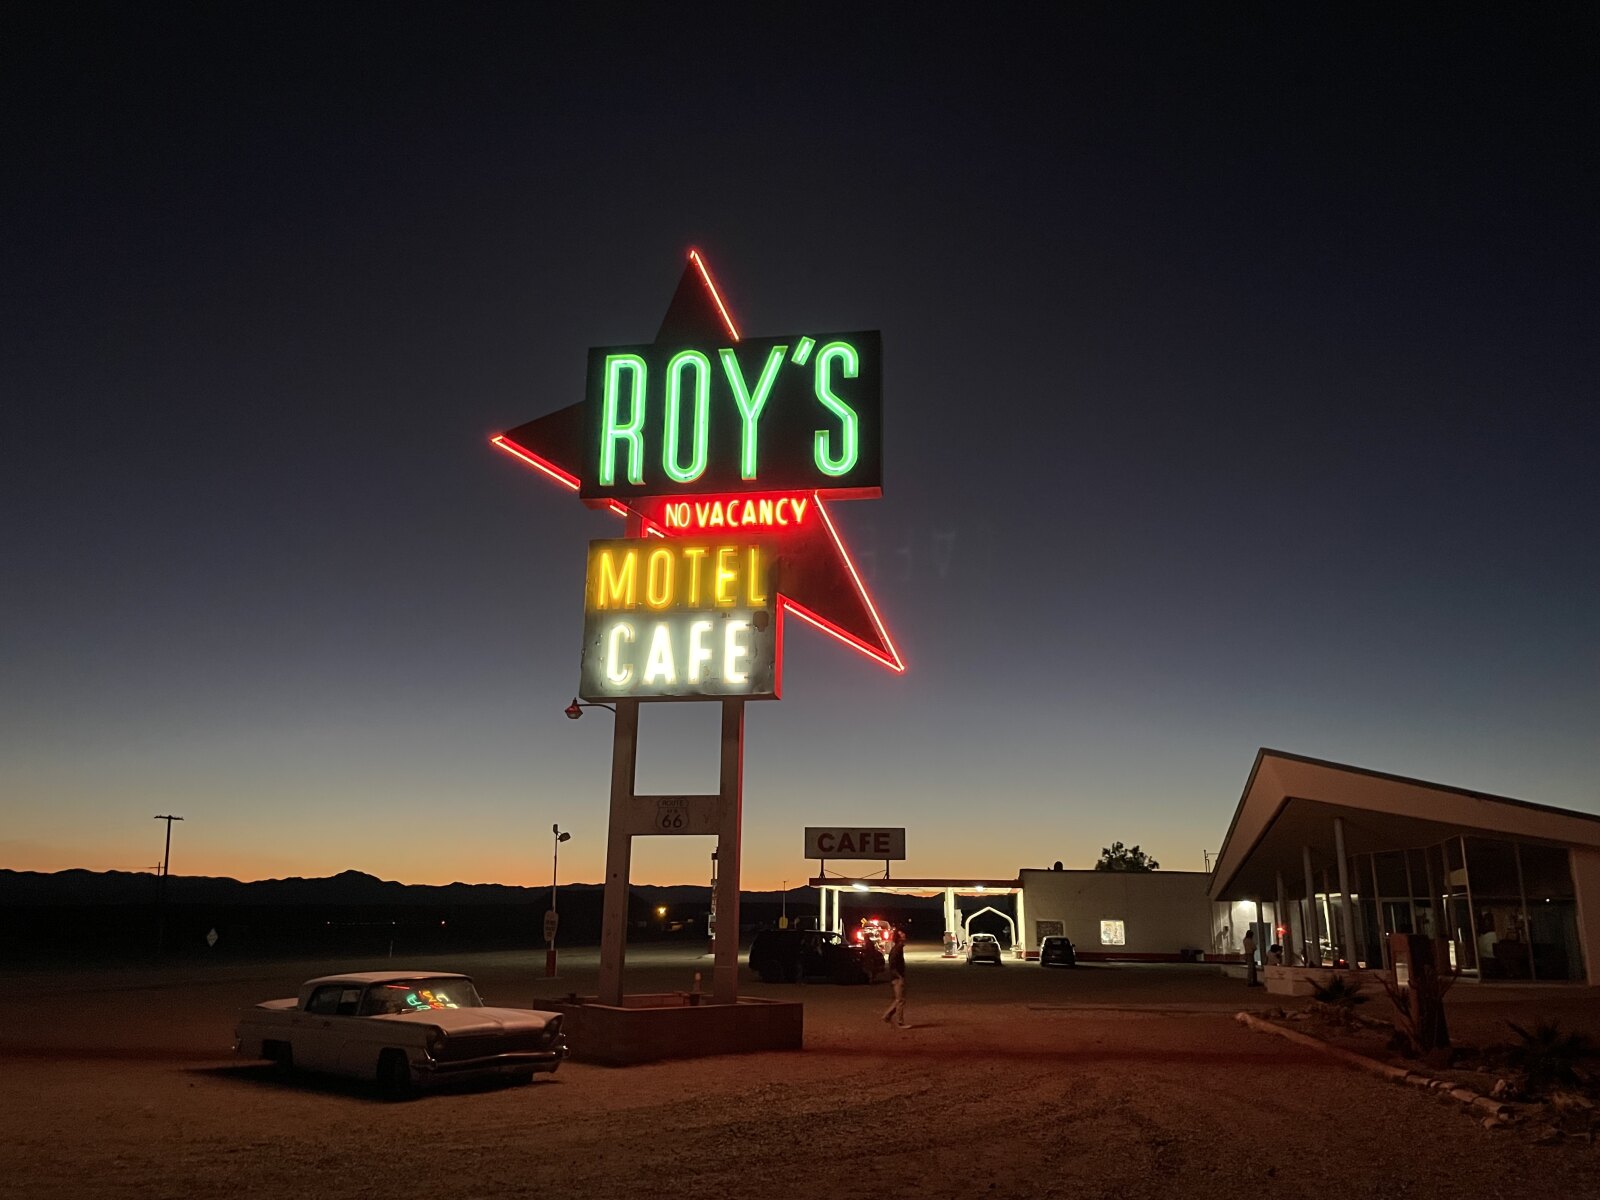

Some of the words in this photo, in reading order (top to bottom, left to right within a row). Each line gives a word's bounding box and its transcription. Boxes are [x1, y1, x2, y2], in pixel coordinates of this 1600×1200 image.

[599, 336, 859, 486] ROY'S
[665, 502, 691, 528] NO
[695, 498, 807, 527] VACANCY
[597, 545, 769, 610] MOTEL
[605, 619, 752, 686] CAFE
[662, 814, 682, 828] 66
[817, 832, 891, 853] CAFE
